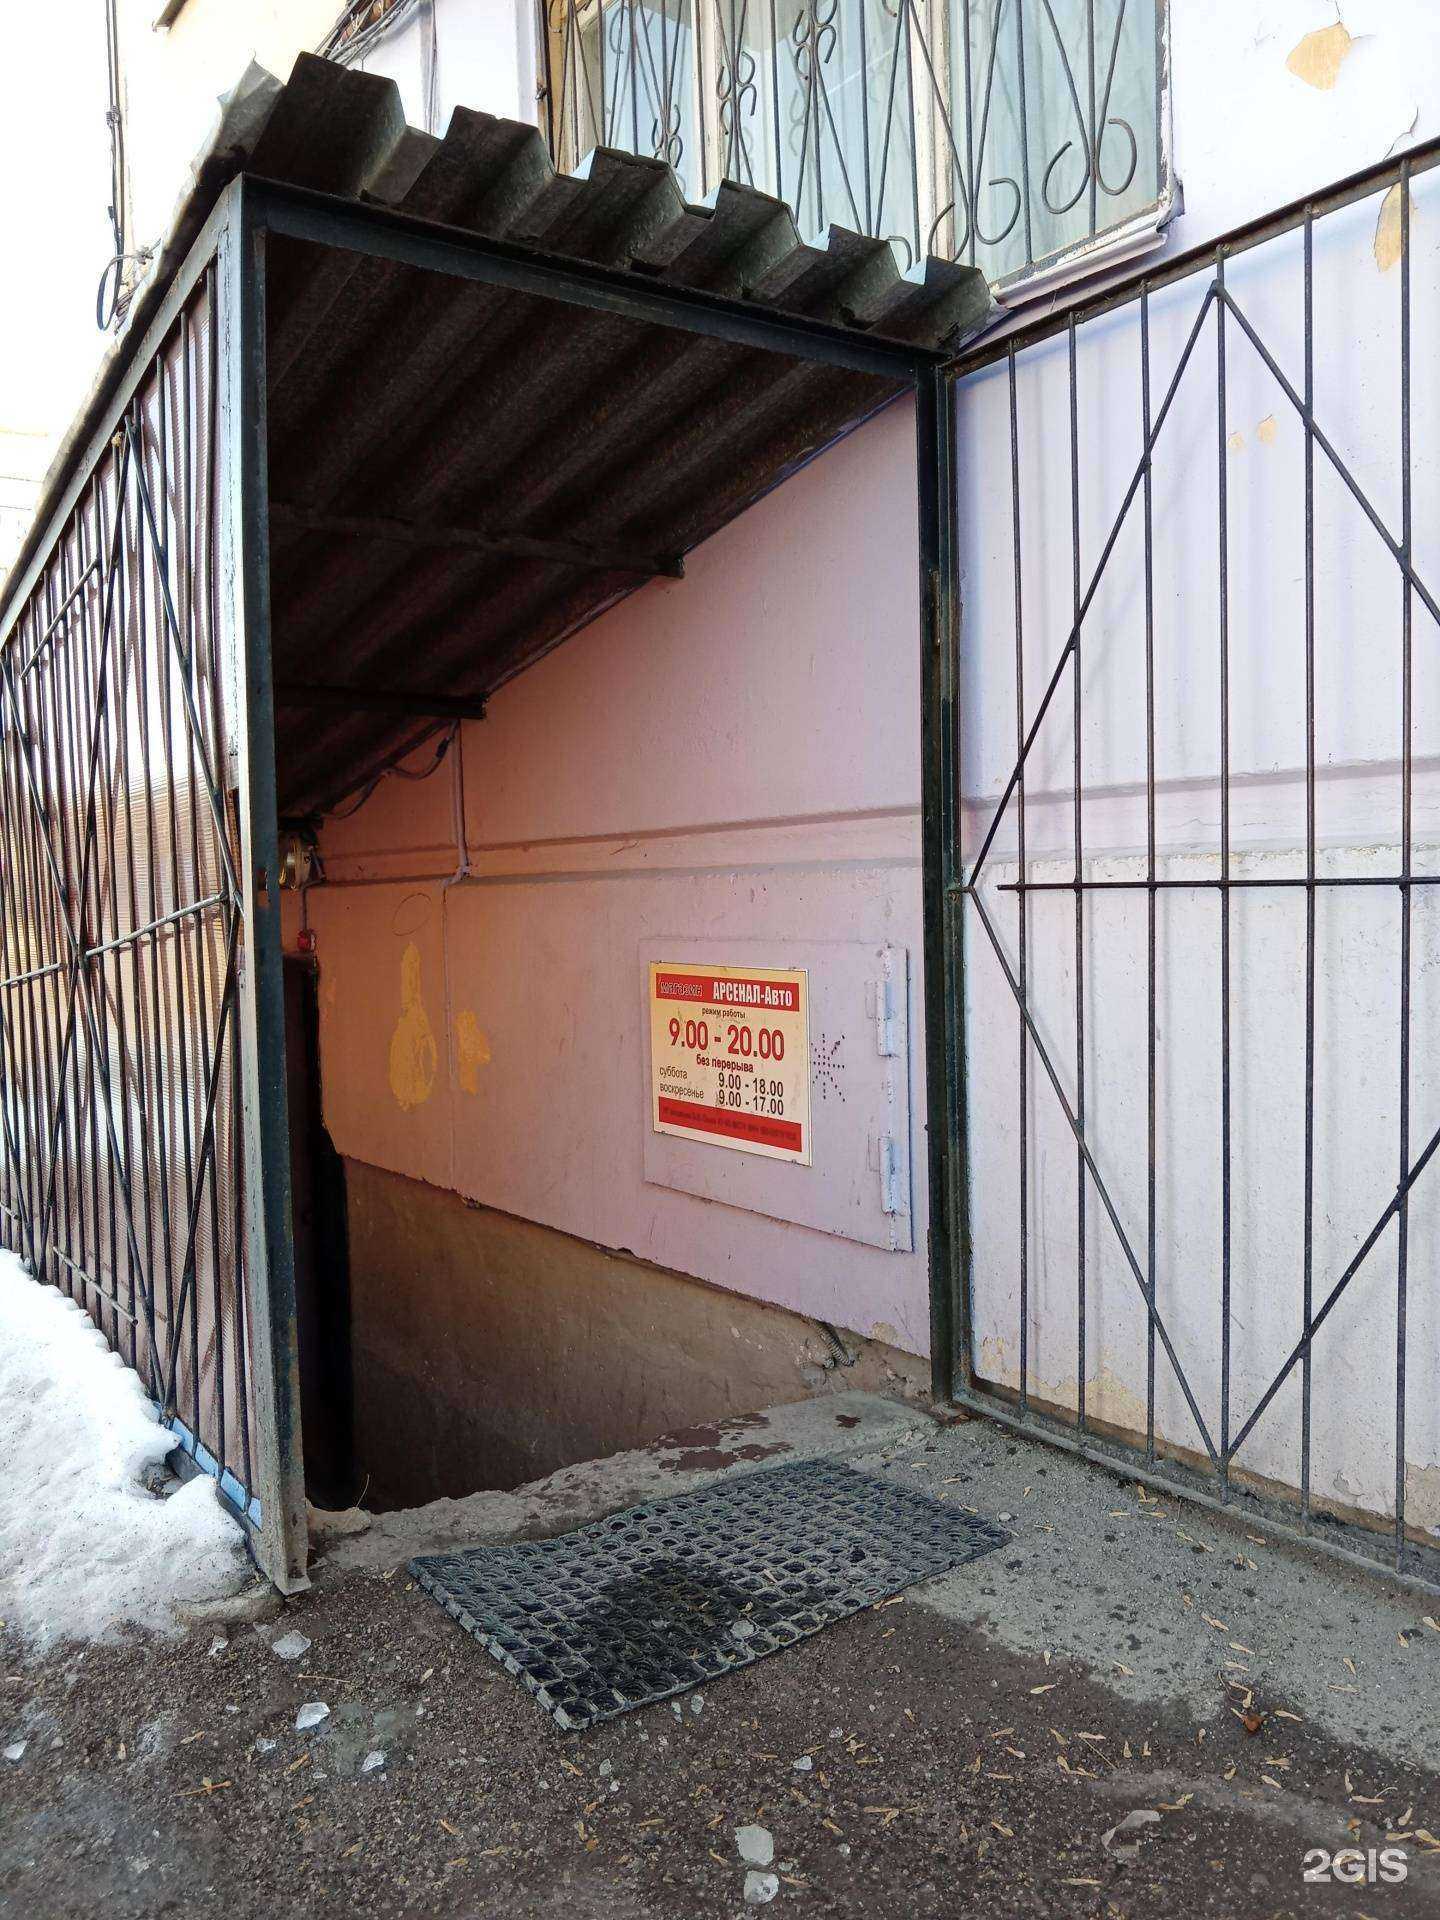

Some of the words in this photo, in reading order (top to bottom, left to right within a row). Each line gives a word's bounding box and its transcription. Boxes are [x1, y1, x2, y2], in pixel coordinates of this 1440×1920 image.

[702, 1007, 721, 1018] режим
[722, 1008, 746, 1019] работы
[669, 1018, 708, 1050] 9.00
[727, 1024, 785, 1061] 20.00
[696, 1054, 710, 1066] без
[712, 1058, 754, 1073] перерыва
[659, 1066, 688, 1079] суббота
[718, 1072, 741, 1090] 9.00
[753, 1078, 784, 1097] 18.00
[660, 1083, 704, 1099] воскресенье
[718, 1090, 741, 1107] 9.00
[753, 1097, 784, 1115] 17.00
